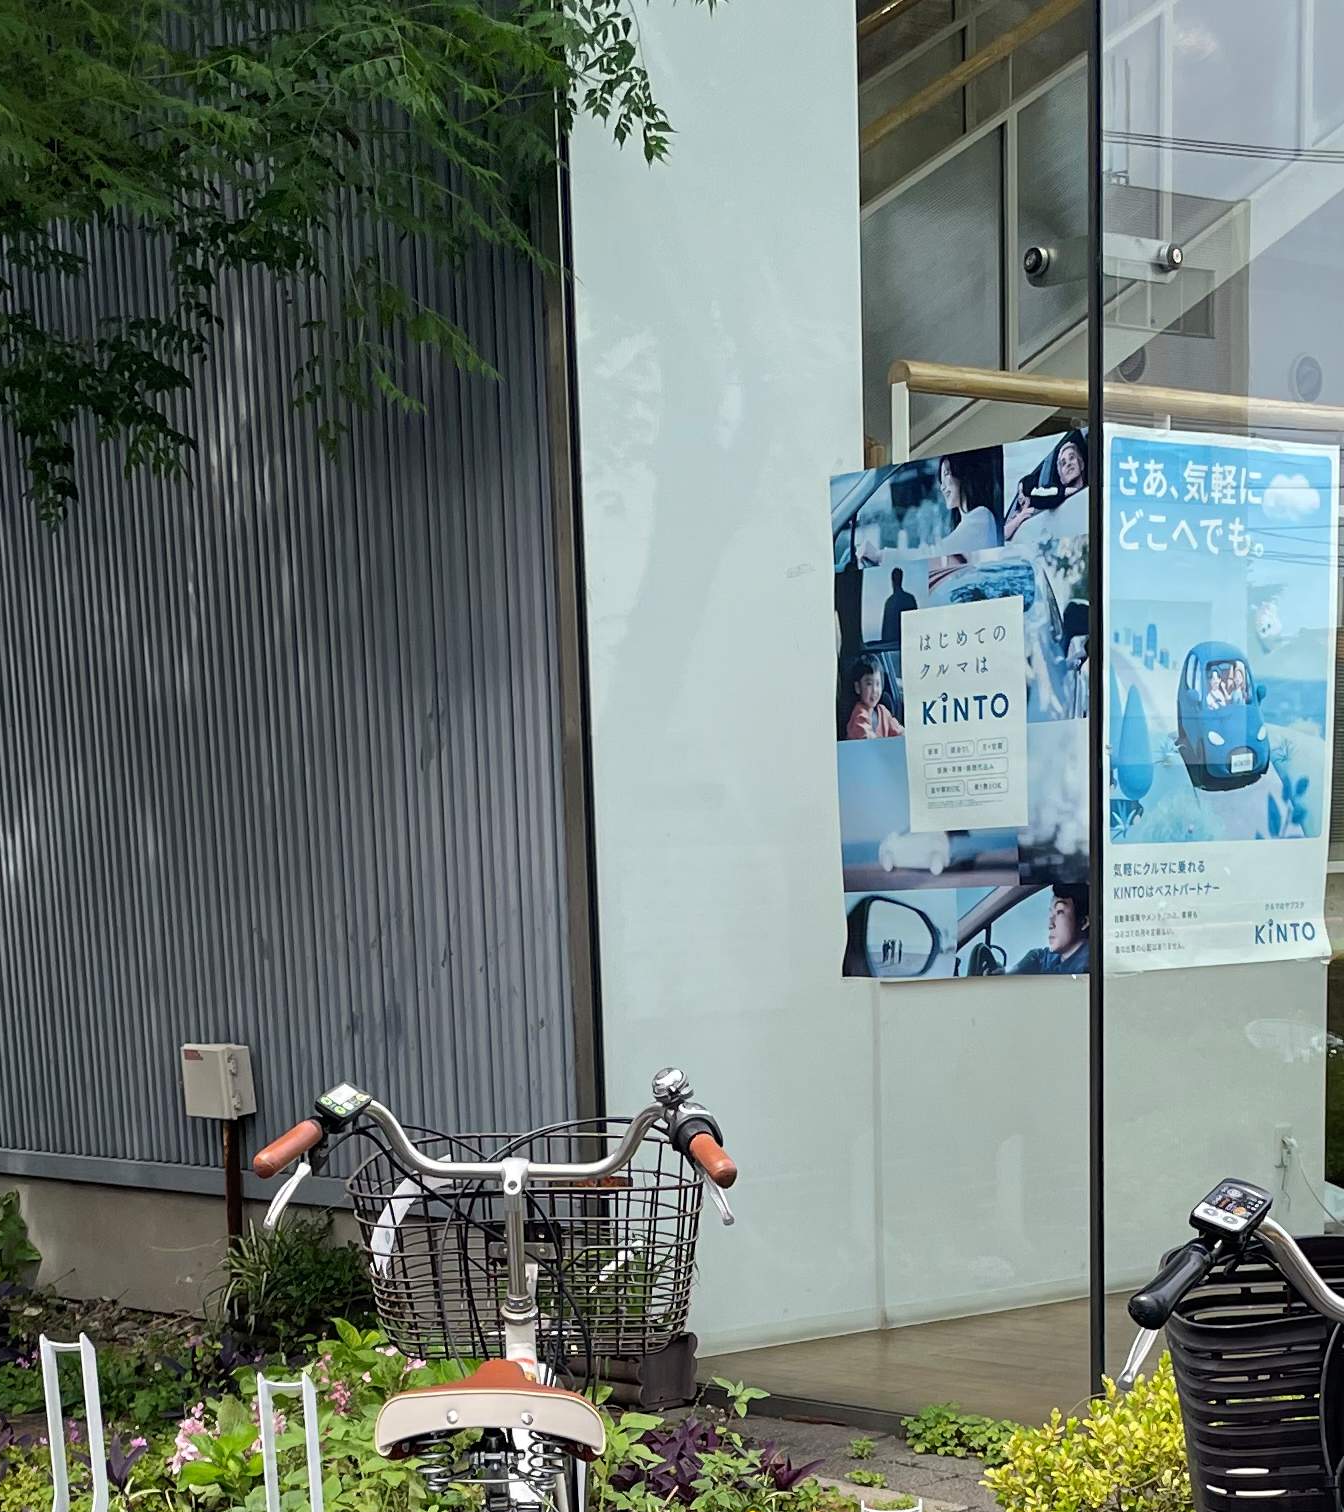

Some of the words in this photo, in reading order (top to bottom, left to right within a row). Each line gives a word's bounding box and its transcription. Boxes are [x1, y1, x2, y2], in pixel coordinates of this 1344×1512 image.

[1118, 456, 1264, 507] さあ、気軽に
[1117, 511, 1264, 557] どこへでも。
[919, 624, 1006, 653] はじめての
[919, 655, 990, 681] クルマは
[1112, 860, 1205, 878] 気軽にクルマに乗れる
